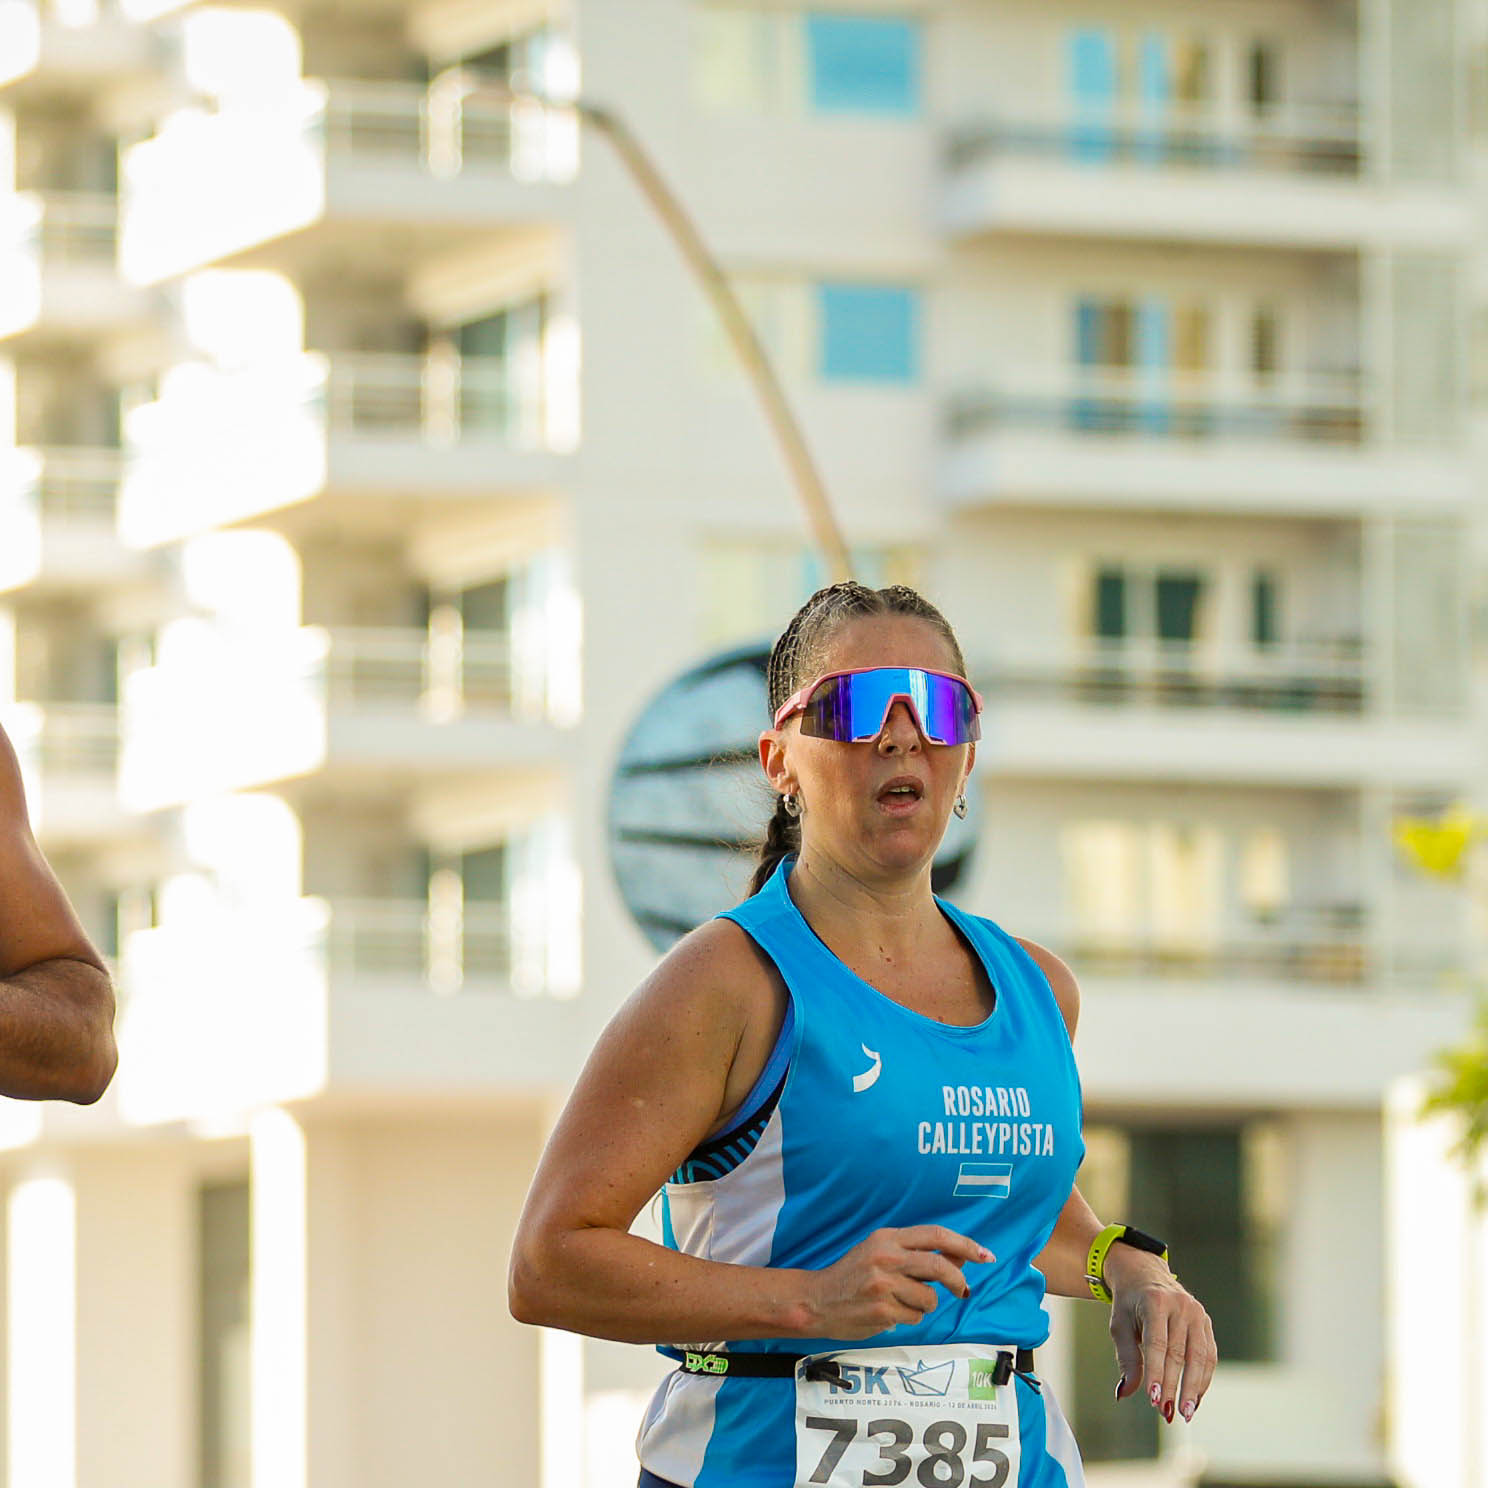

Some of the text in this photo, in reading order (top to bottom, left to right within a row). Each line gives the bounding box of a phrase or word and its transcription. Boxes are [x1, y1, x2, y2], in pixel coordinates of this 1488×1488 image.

[941, 1085, 1032, 1118] ROSARIO
[917, 1121, 1055, 1157] CALLEYPISTA
[971, 1371, 993, 1388] 10K
[909, 1400, 941, 1408] ROSARIO
[967, 1402, 983, 1410] ABRIL
